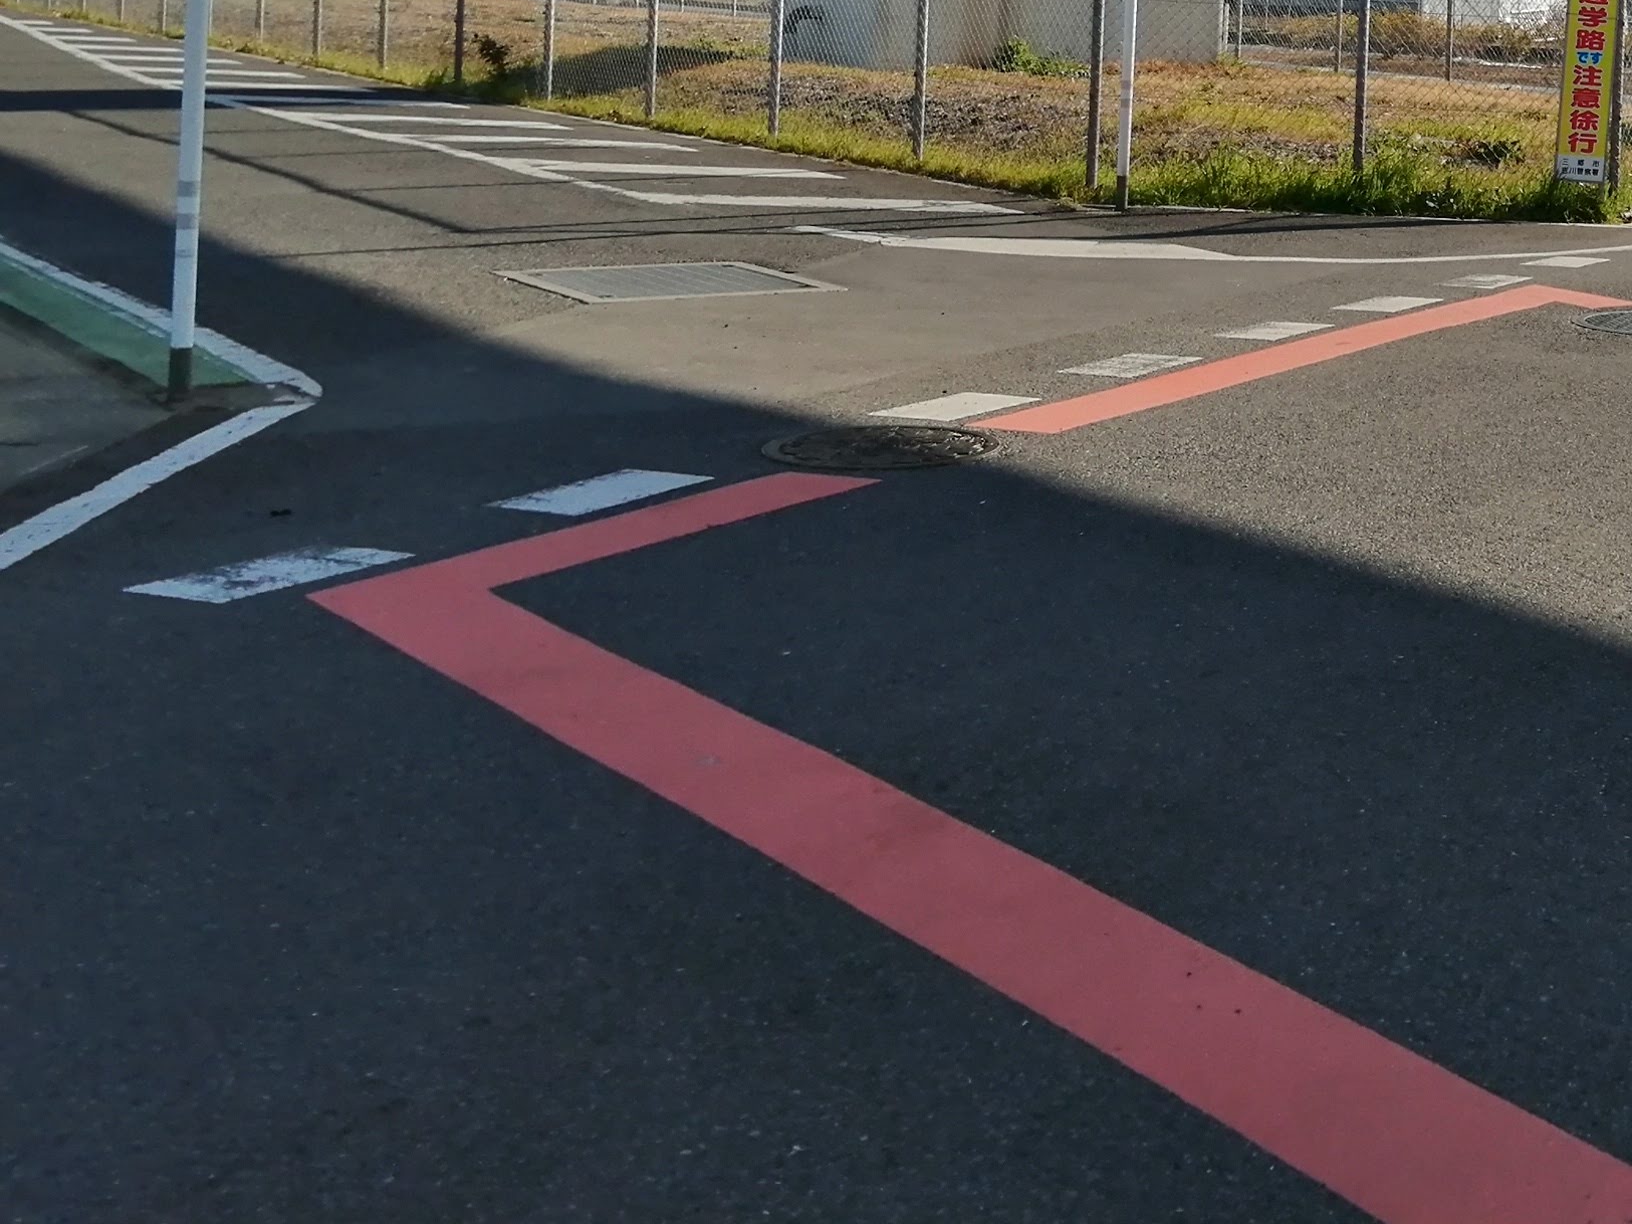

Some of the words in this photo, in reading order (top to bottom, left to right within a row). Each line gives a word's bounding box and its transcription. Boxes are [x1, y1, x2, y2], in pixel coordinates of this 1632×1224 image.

[1577, 52, 1603, 64] です
[1568, 64, 1603, 154] 注意徐行
